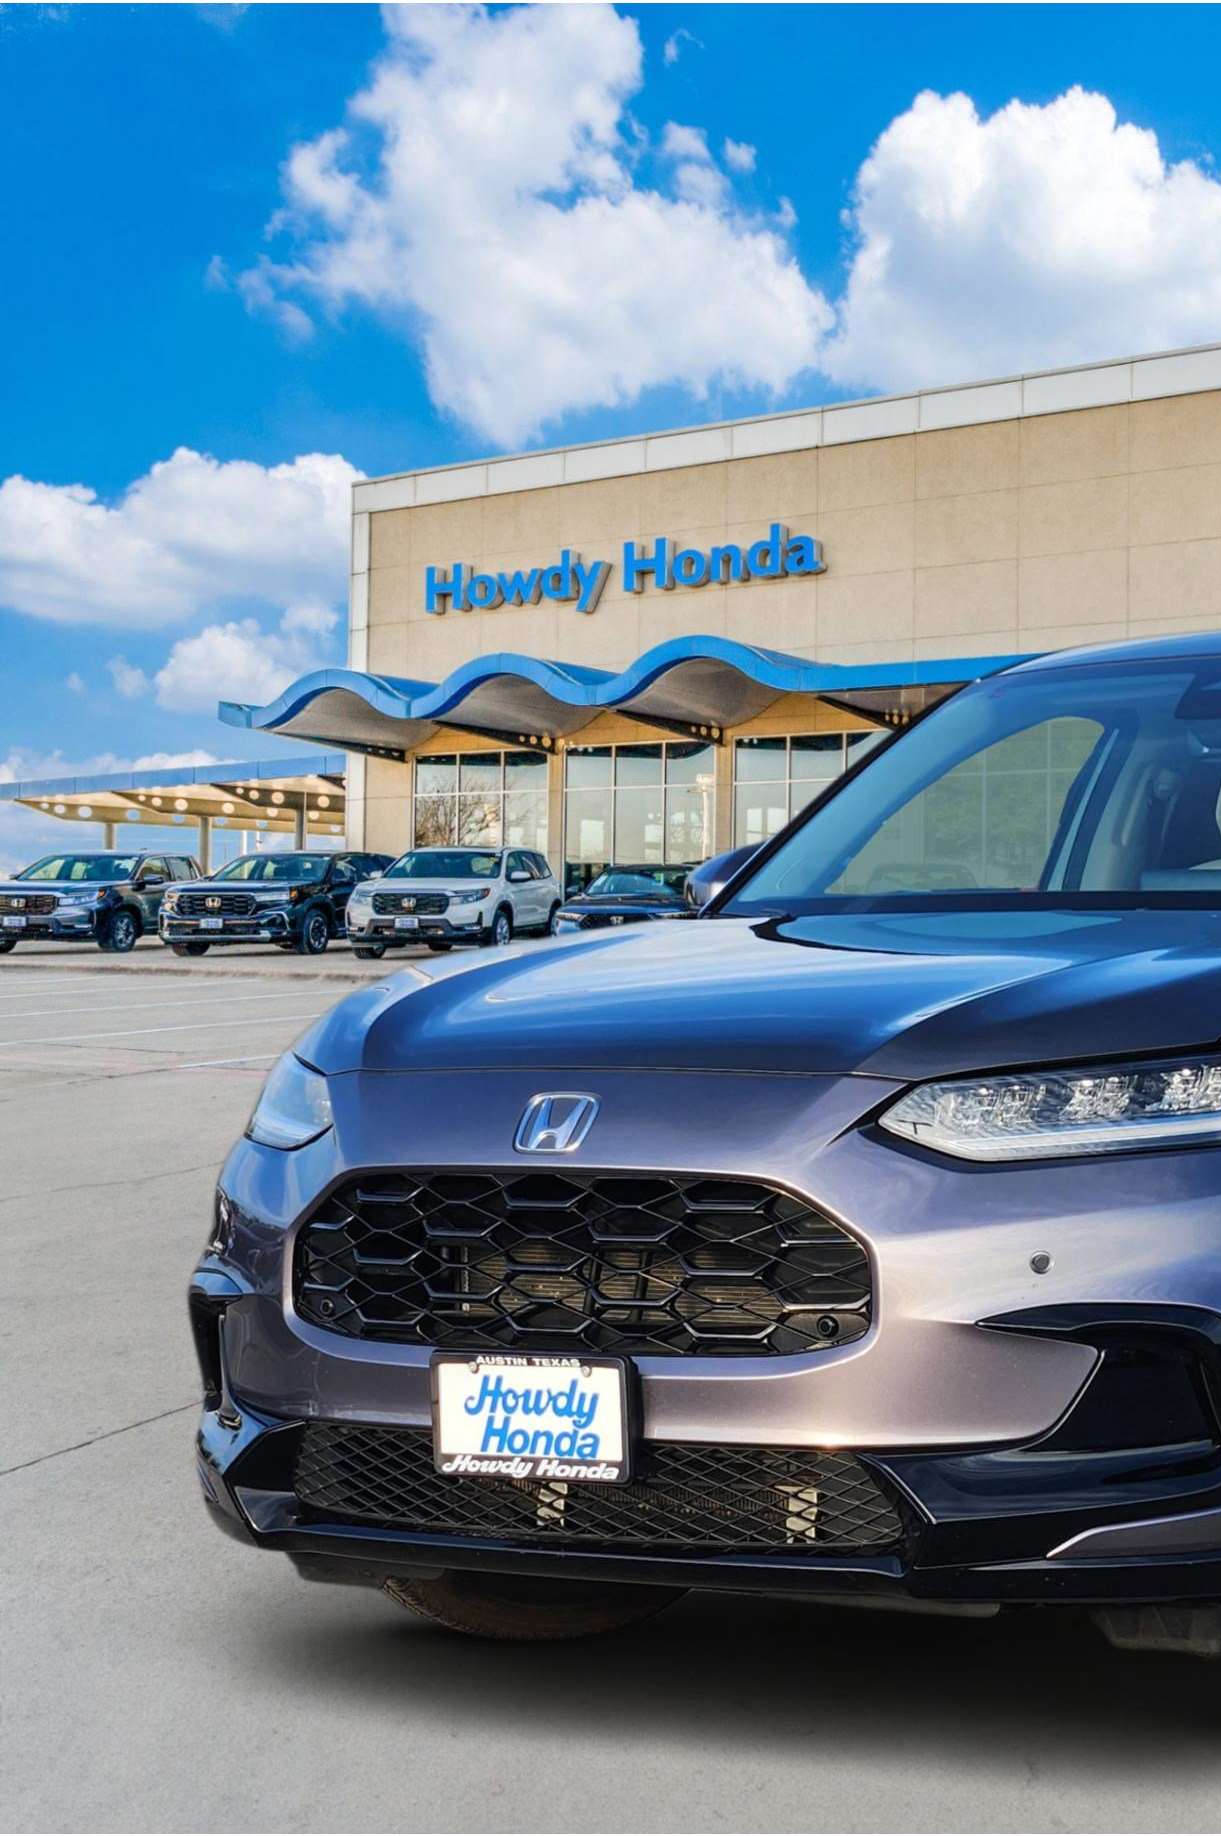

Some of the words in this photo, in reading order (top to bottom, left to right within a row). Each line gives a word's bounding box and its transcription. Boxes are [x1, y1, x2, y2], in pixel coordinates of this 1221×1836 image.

[424, 548, 612, 614] Howdy
[622, 522, 827, 594] Honda
[476, 1355, 528, 1366] AUSTIN
[532, 1358, 581, 1368] TEXAS
[464, 1374, 599, 1429] Howdy
[480, 1415, 601, 1460] Honda
[442, 1454, 534, 1479] Howdy
[536, 1461, 619, 1480] Honda
